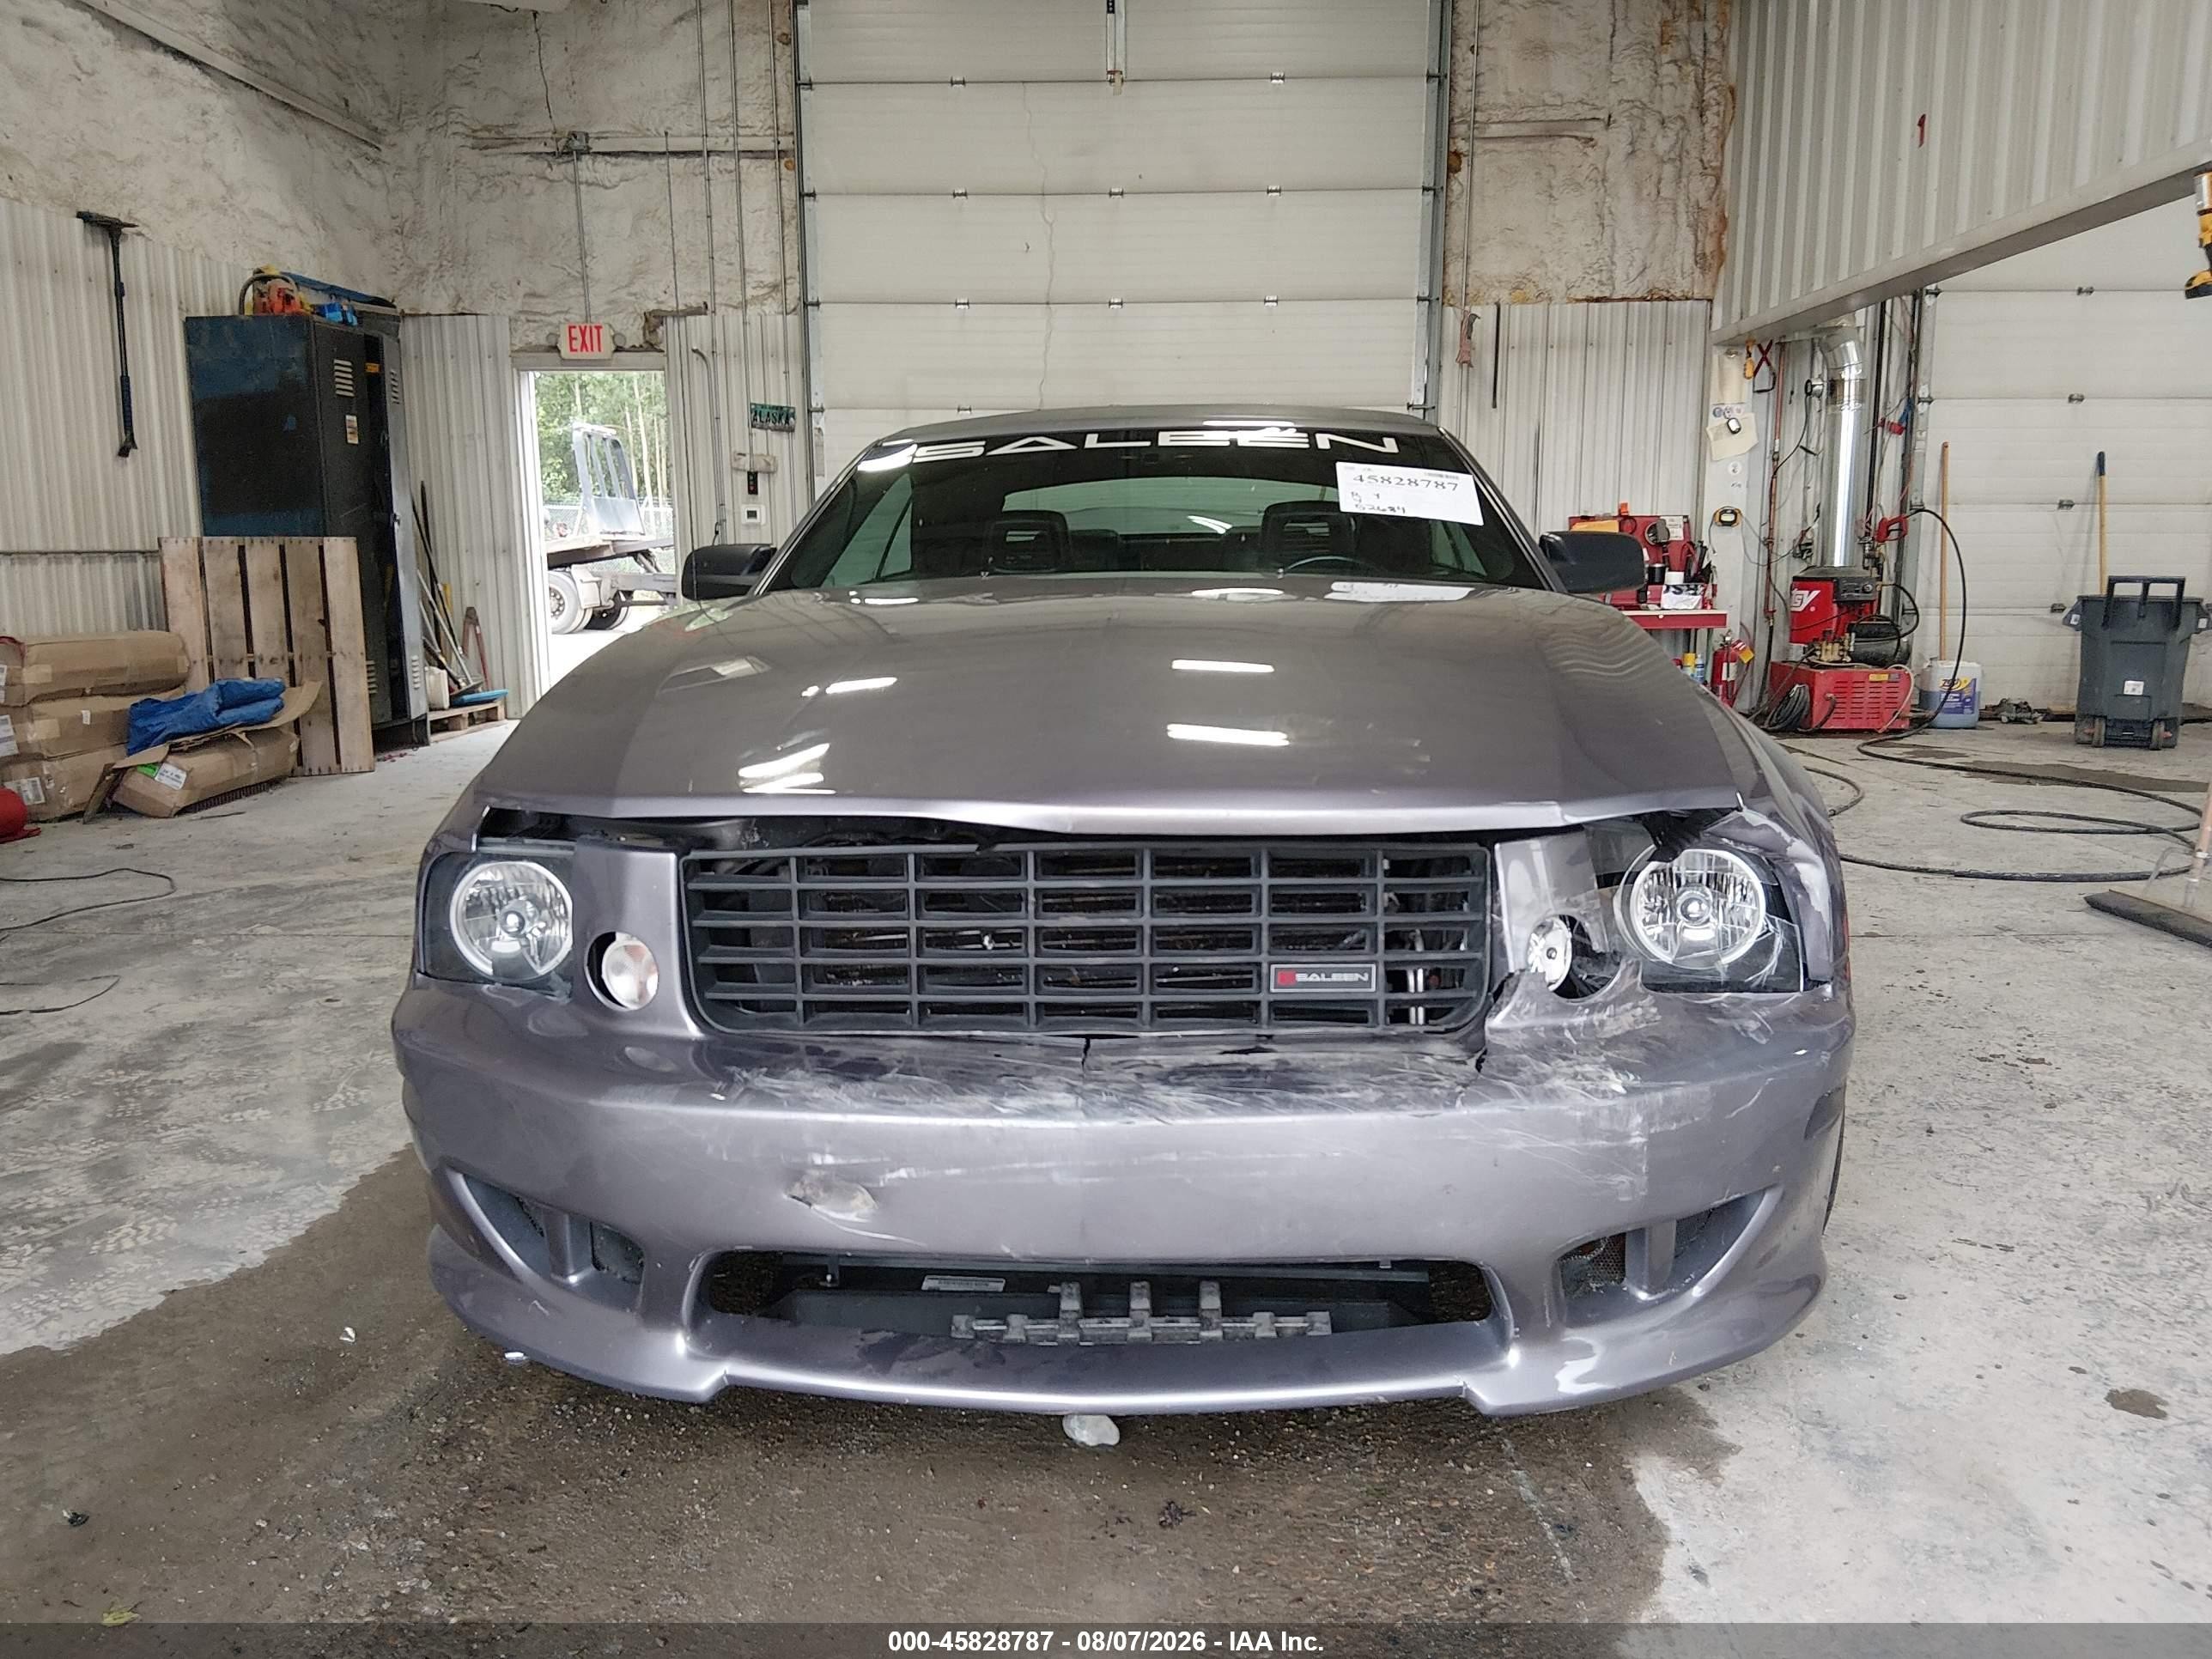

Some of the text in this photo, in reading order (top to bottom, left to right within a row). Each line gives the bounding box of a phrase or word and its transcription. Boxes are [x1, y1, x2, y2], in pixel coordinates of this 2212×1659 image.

[568, 325, 603, 352] EXIT
[752, 410, 790, 426] ALASKA
[912, 428, 1400, 464] SALEEN
[1352, 474, 1458, 492] 45828787
[1295, 972, 1370, 982] SALEEN
